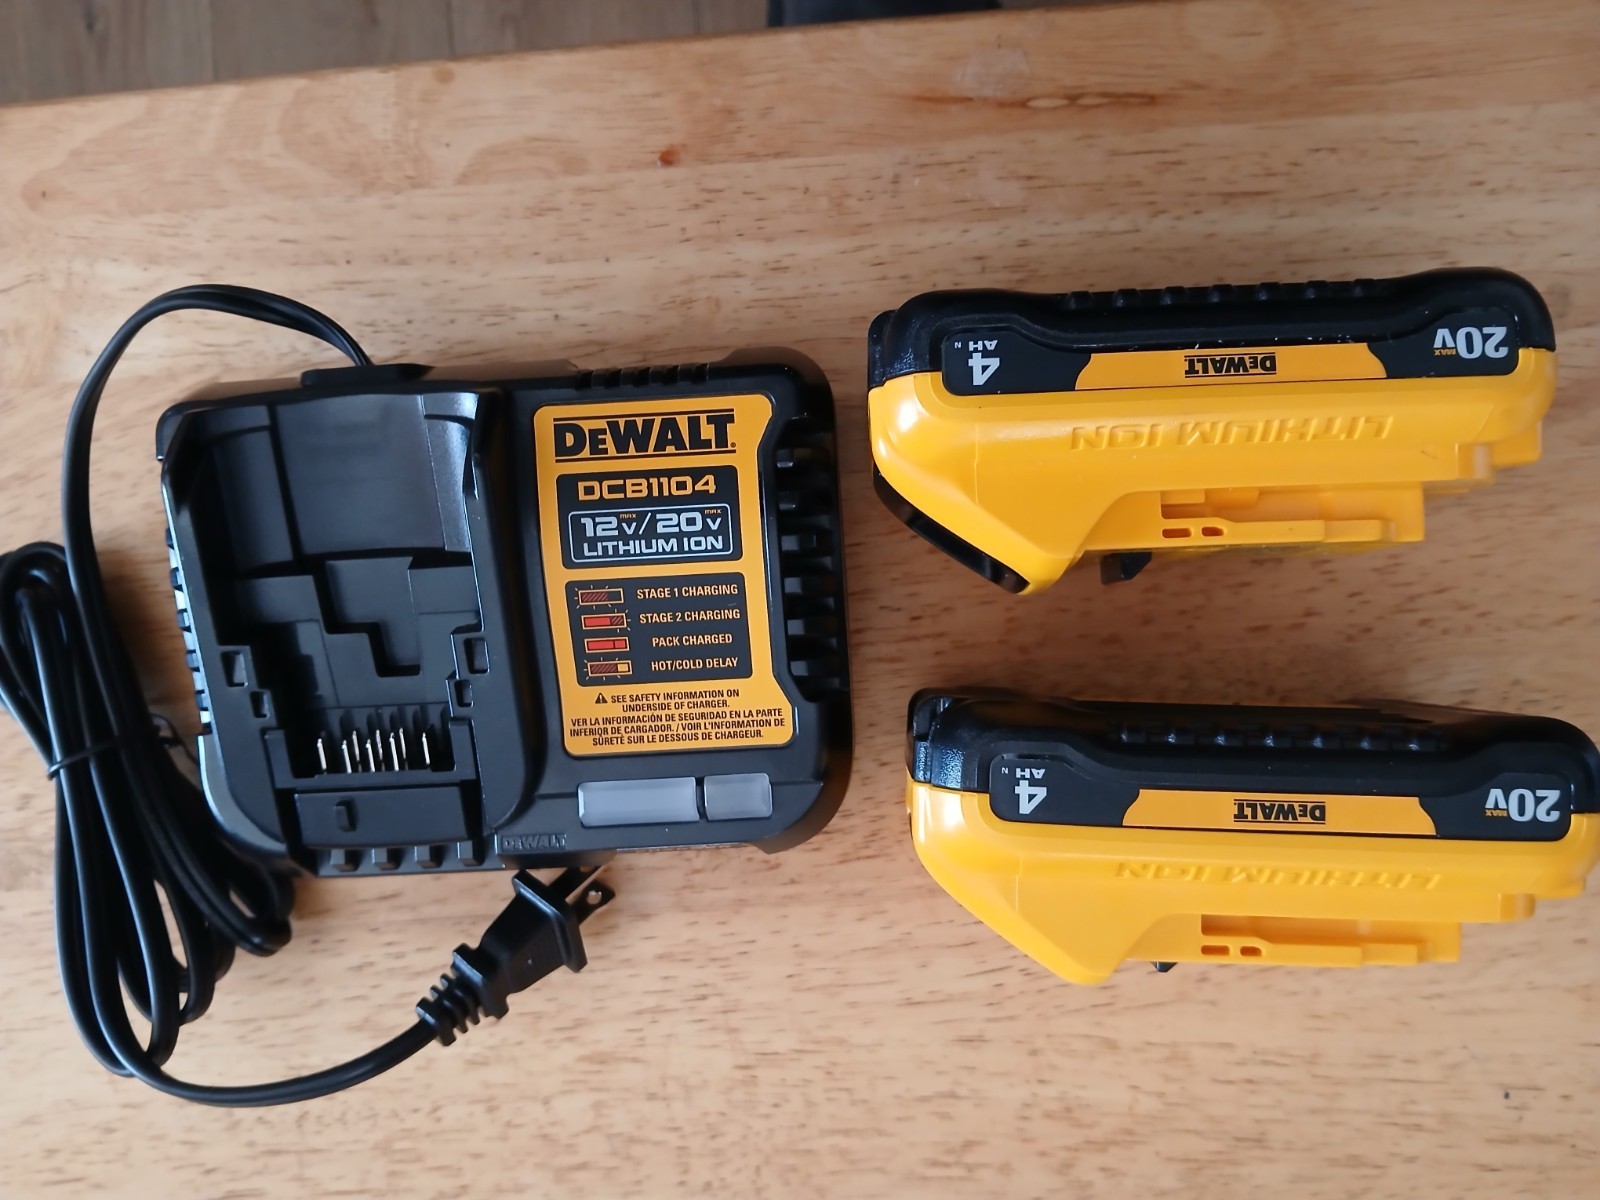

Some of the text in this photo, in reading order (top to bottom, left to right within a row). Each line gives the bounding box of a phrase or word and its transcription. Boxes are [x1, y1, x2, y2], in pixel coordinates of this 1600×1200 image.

[968, 340, 998, 351] AH
[968, 352, 1000, 386] 4
[1070, 415, 1395, 450] LITHIUM ION
[577, 474, 717, 501] DCB1104
[583, 535, 723, 556] LITHIUM ION
[636, 584, 738, 600] STAGE 1 CHARGING
[639, 609, 741, 624] STAGE 2 CHARGING
[652, 633, 733, 648] PACK CHARGED
[651, 657, 739, 671] HOT/COLD DELAY
[610, 689, 740, 704] SEE SAFETY INFORMATION ON
[622, 699, 730, 712] UNDERSIDE OF CHARGER.
[570, 707, 783, 727] VER LA INFORMACIÓN DE SEGURIDAD EN LA PARTE
[569, 726, 609, 737] INFERIOR
[610, 725, 622, 735] DE
[624, 723, 674, 734] CARGADOR.
[681, 722, 702, 731] VOIR
[703, 718, 772, 731] L'INFORMATION
[773, 718, 786, 727] DE
[627, 735, 645, 744] SUR
[647, 734, 657, 743] LE
[658, 732, 699, 743] DESSOUS
[701, 731, 713, 741] DE
[714, 729, 764, 740] CHARGEUR.
[1015, 767, 1046, 779] AH
[1014, 780, 1047, 815] 4
